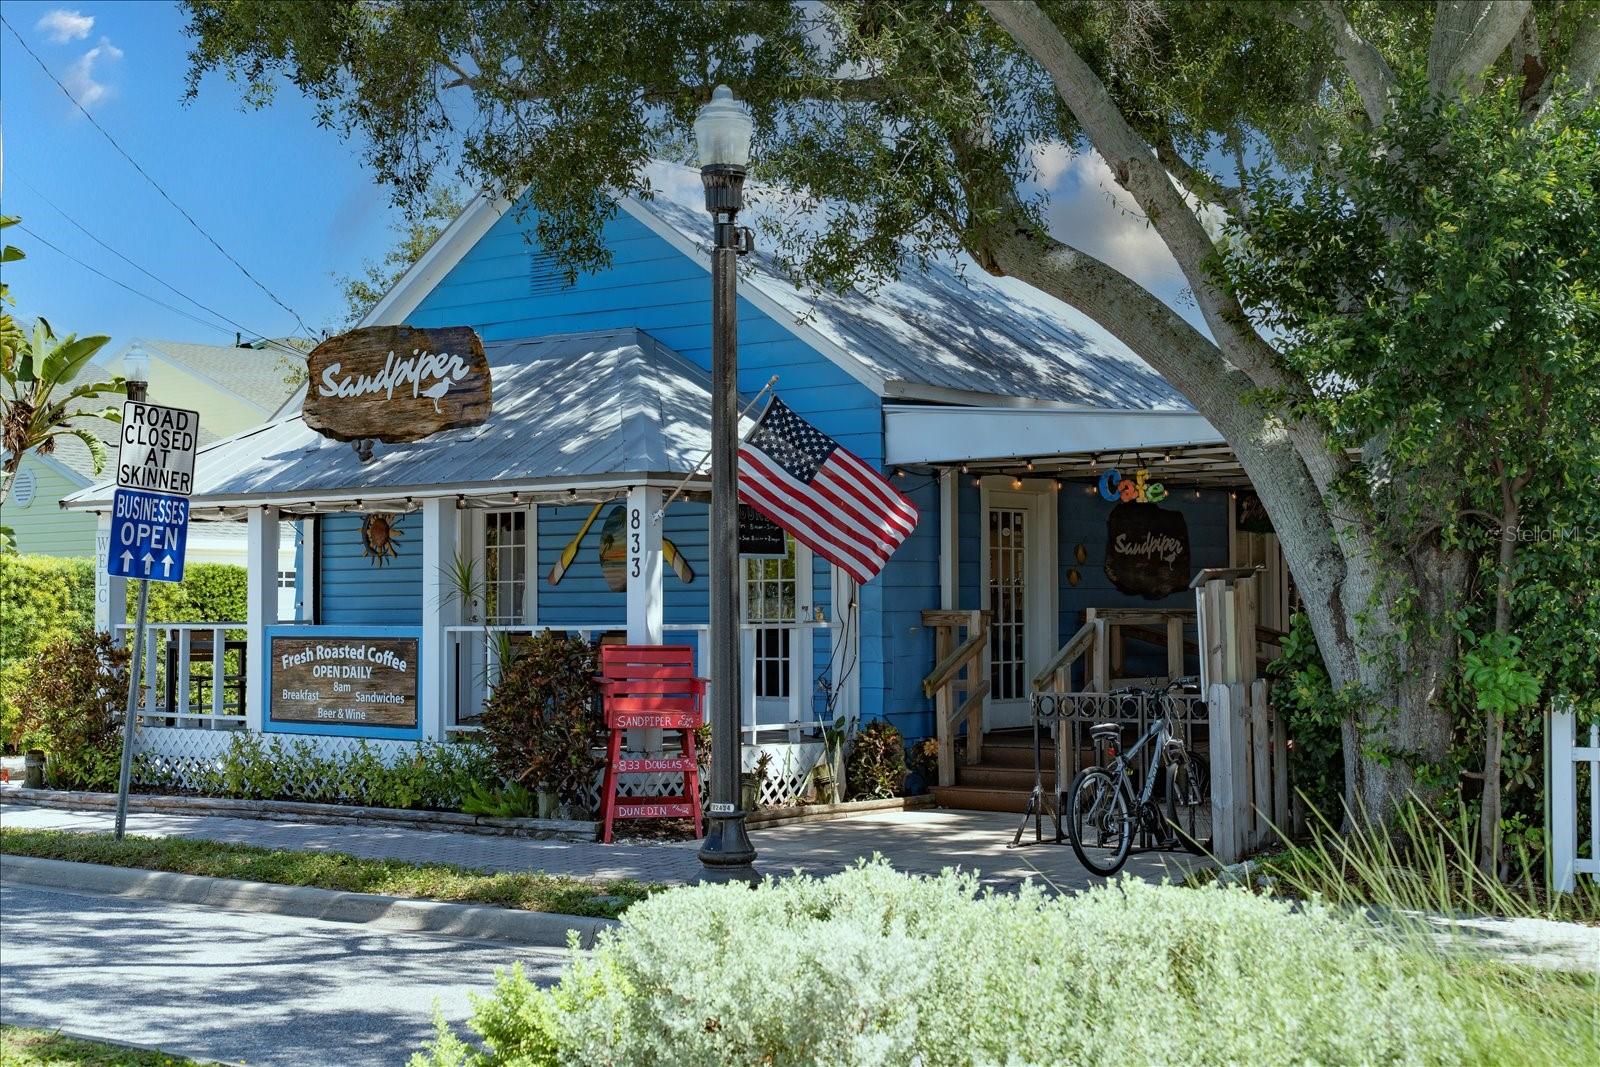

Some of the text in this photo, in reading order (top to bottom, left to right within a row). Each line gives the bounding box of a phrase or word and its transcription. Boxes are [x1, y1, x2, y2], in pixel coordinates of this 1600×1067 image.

[318, 348, 470, 400] Sandpiper
[133, 405, 189, 431] ROAD
[124, 424, 193, 452] CLOSED
[144, 447, 171, 469] AT
[120, 464, 191, 492] SKINNER
[1099, 468, 1166, 503] Cafe
[116, 494, 185, 526] BUSINESSES
[120, 521, 178, 551] OPEN
[631, 508, 641, 578] 833
[1114, 532, 1183, 561] Sandpiper
[281, 645, 407, 673] Fresh Roasted Coffee
[312, 665, 373, 679] OPEN DAILY
[282, 689, 320, 701] Breakfast
[333, 681, 351, 692] 8am
[355, 691, 405, 704] Sandwiches
[317, 707, 366, 720] Beer & Wine
[616, 715, 672, 728] SANDPIPER
[618, 760, 640, 771] 833
[645, 760, 683, 770] DOUGLAS
[619, 807, 668, 817] DUNEDIN
